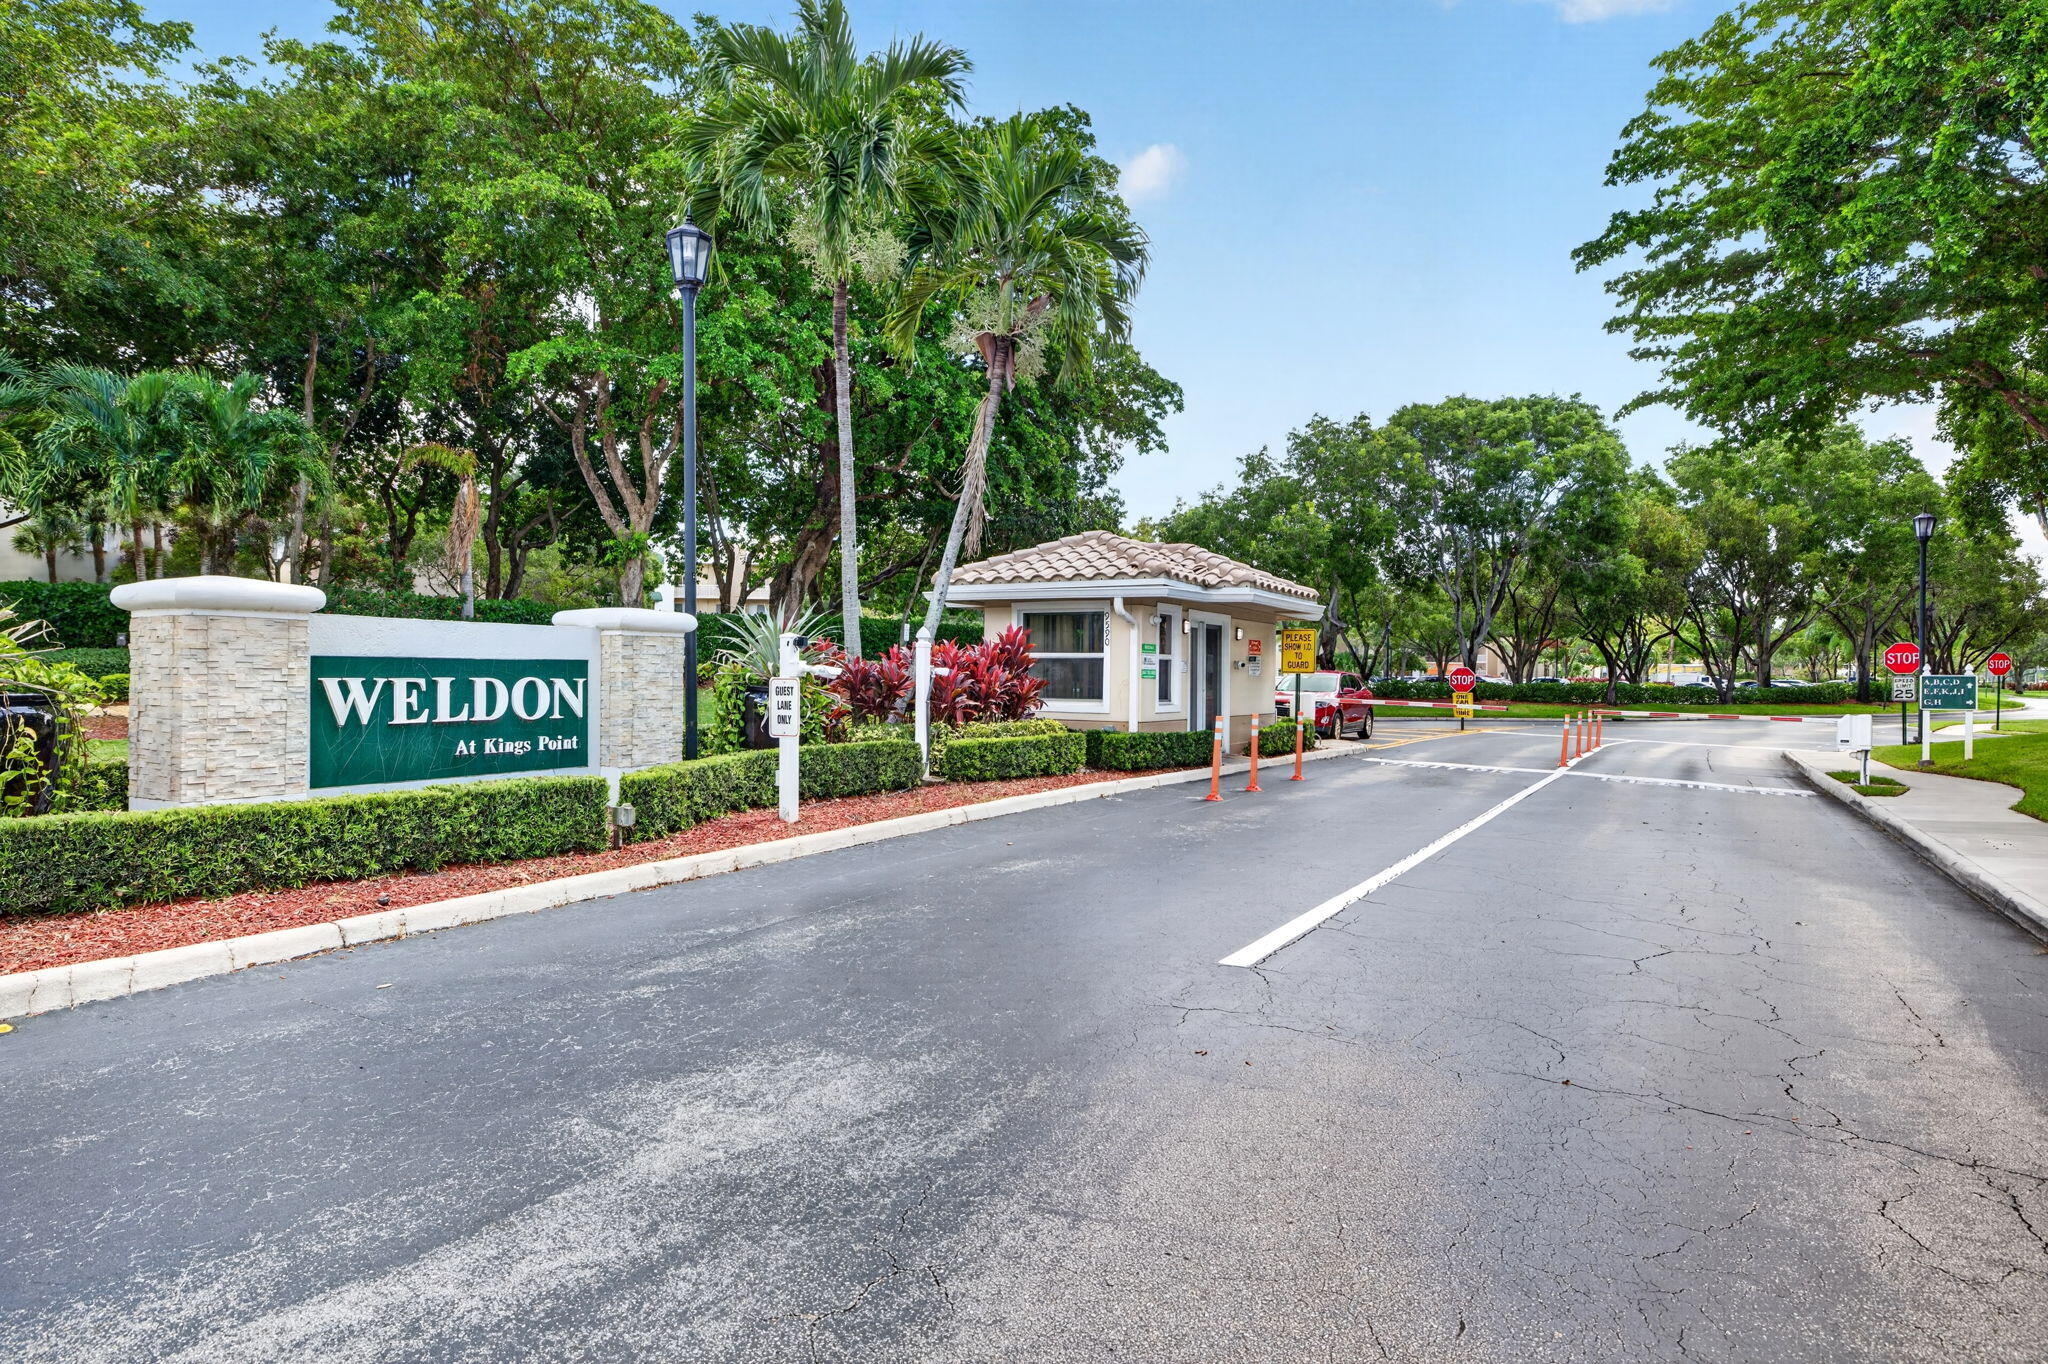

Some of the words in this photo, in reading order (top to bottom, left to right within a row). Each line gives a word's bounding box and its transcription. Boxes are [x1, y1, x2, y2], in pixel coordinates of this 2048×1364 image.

[1285, 633, 1312, 642] PLEASE
[1284, 643, 1302, 651] SHOW
[1294, 652, 1303, 660] TO
[1887, 652, 1919, 664] STOP
[1287, 661, 1310, 669] GUARD
[1989, 660, 2010, 668] STOP
[1451, 675, 1474, 685] STOP
[775, 686, 794, 696] GUEST
[1894, 689, 1914, 699] 25
[318, 676, 587, 727] WELDON
[777, 700, 792, 710] LANE
[777, 714, 792, 724] ONLY
[455, 739, 476, 756] At
[484, 736, 532, 755] Kings
[538, 734, 579, 751] Point
